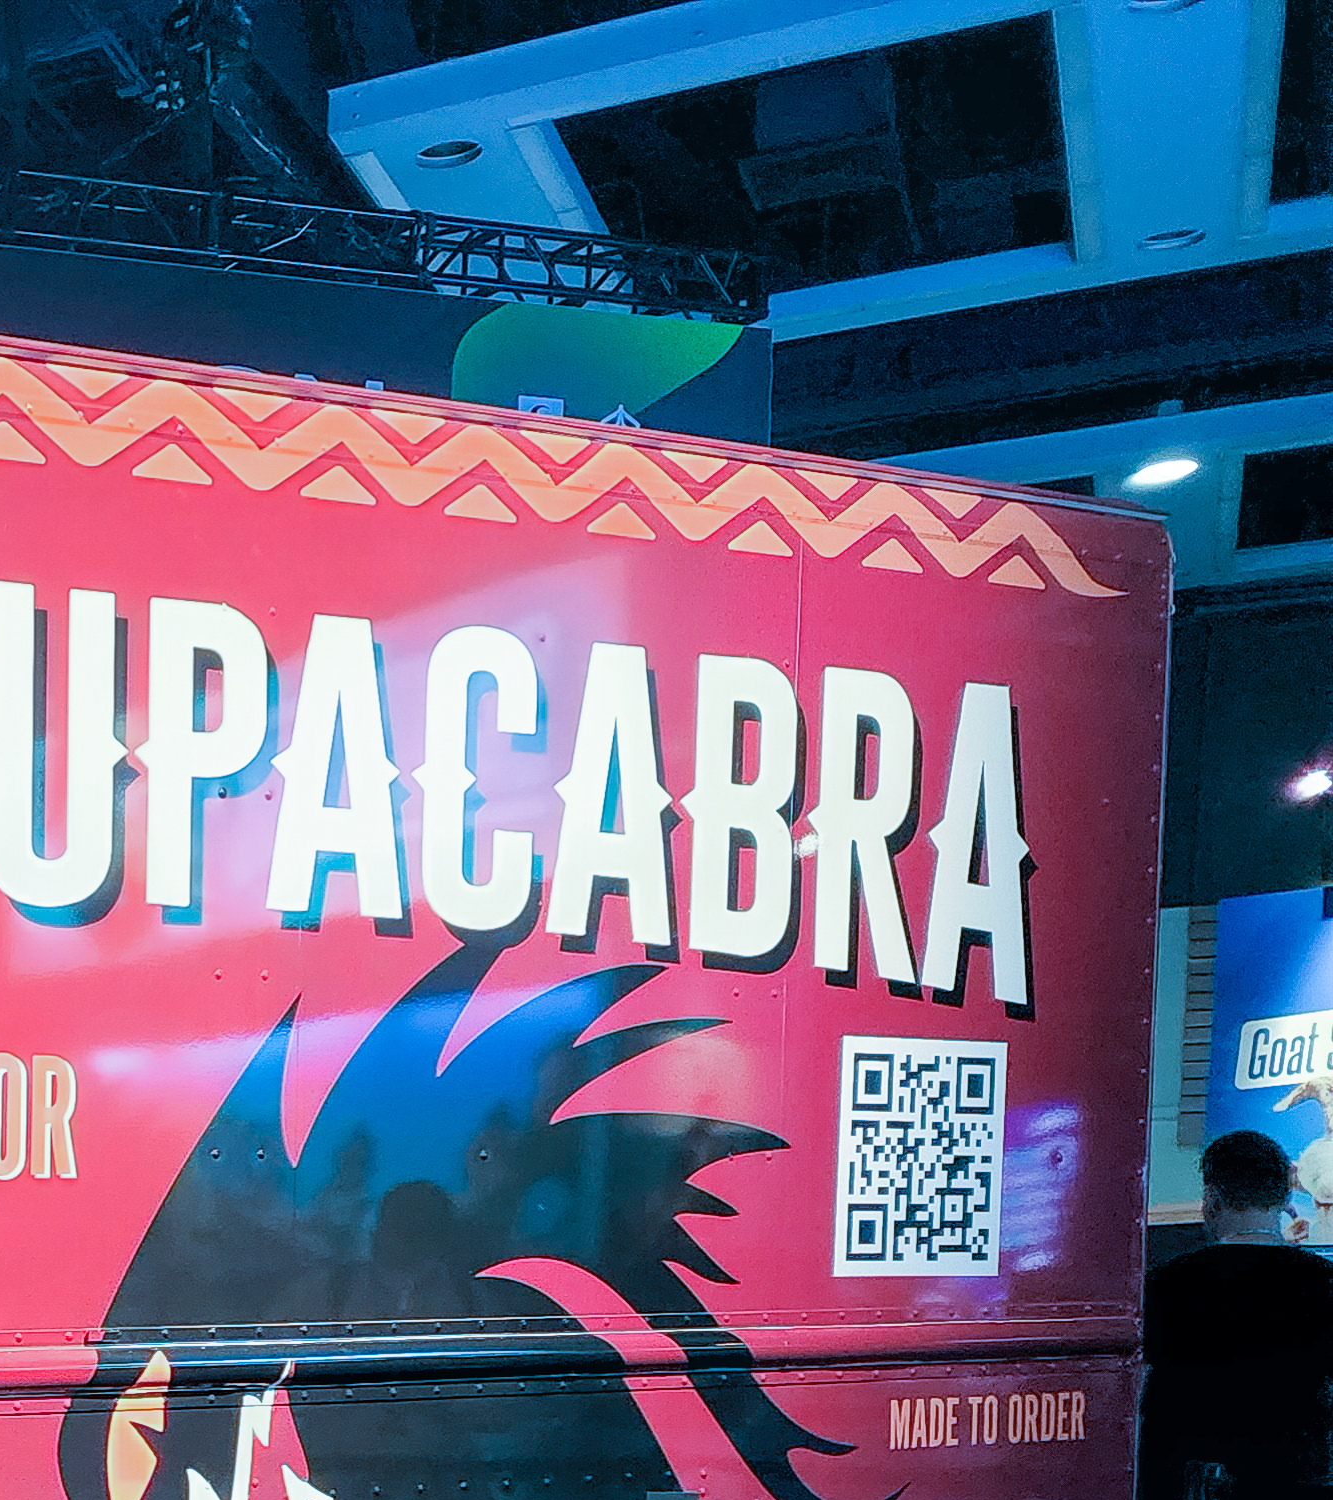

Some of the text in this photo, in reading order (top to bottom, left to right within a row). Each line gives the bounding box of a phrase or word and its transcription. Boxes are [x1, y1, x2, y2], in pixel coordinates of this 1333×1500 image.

[1248, 1022, 1319, 1079] Goat
[889, 1391, 1086, 1450] MADE TO ORDER
